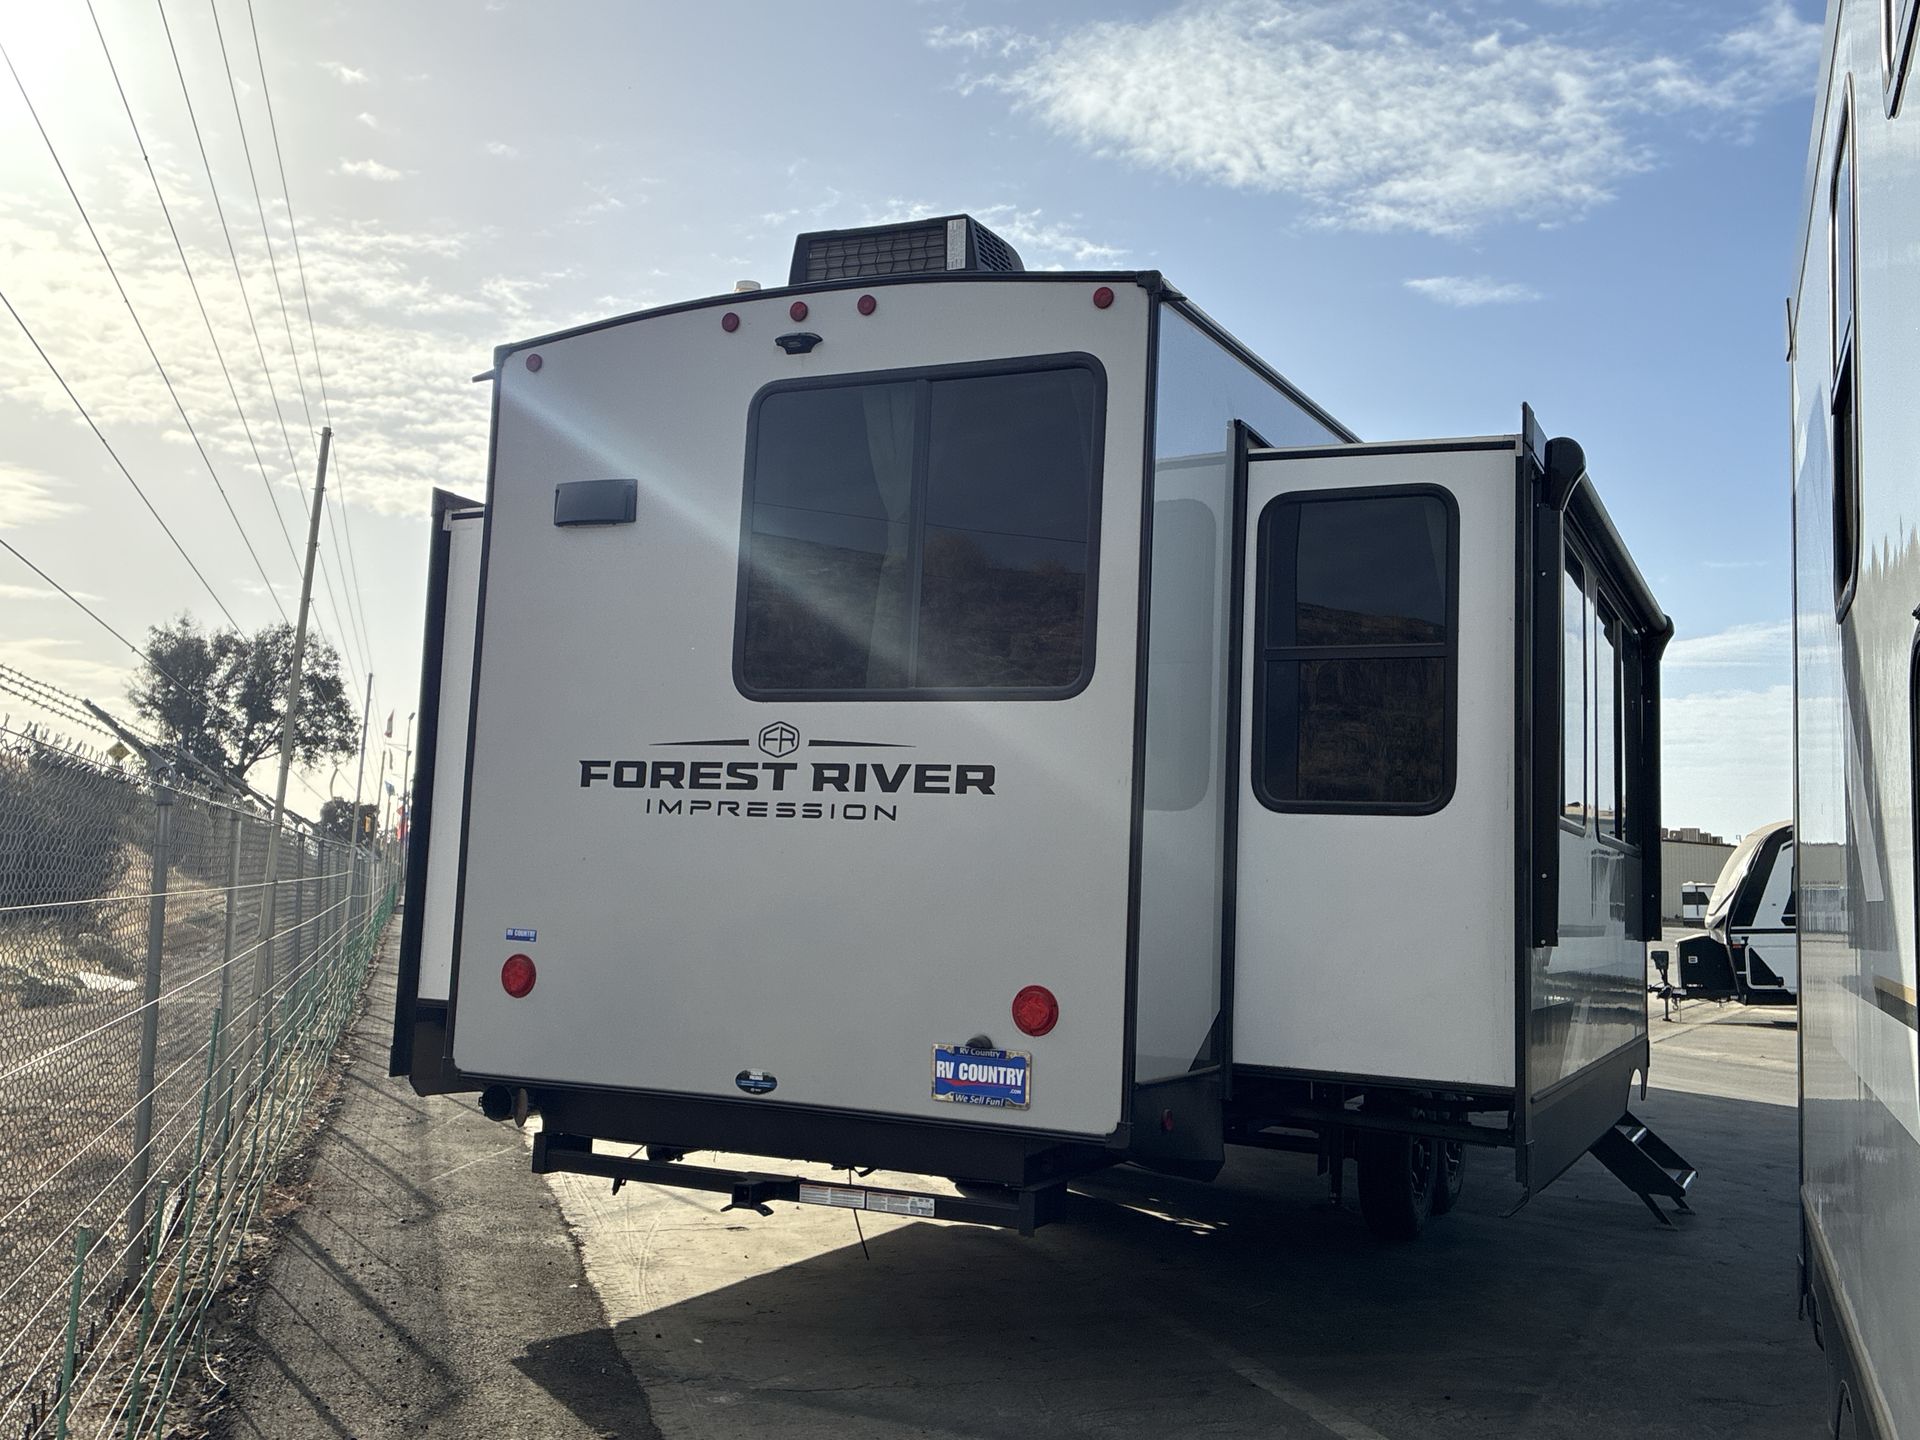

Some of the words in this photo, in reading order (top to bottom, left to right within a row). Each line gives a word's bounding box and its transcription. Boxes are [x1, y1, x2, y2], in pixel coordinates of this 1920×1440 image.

[579, 760, 798, 791] FOREST
[810, 762, 997, 796] RIVER
[646, 798, 897, 822] IMPRESSION
[960, 1047, 969, 1055] RV
[970, 1048, 1001, 1058] Country
[936, 1060, 955, 1079] RV
[958, 1062, 1025, 1087] COUNTRY
[955, 1093, 968, 1103] We
[970, 1095, 984, 1105] Sell
[985, 1096, 1004, 1107] Fun!
